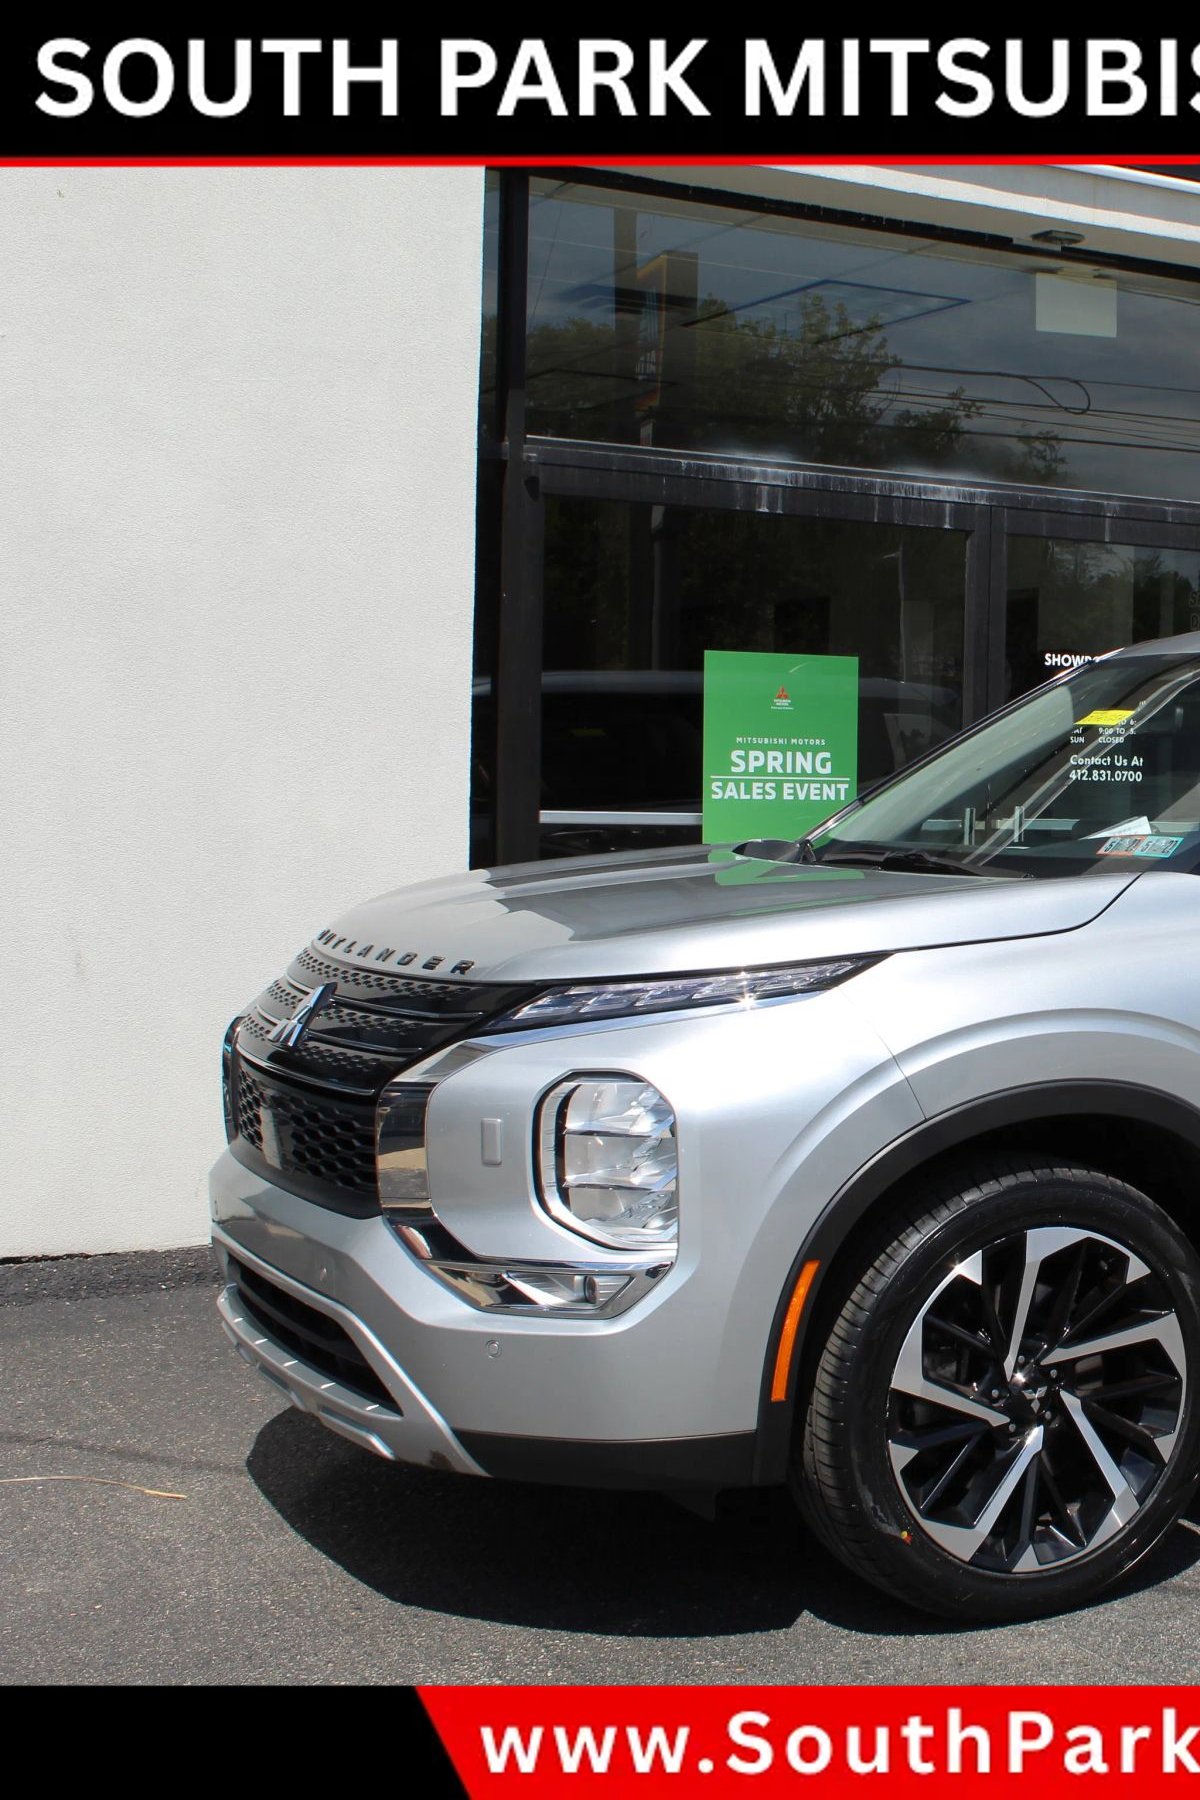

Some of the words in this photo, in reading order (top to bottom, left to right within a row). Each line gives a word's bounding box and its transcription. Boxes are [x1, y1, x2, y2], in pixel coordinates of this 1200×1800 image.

[736, 736, 788, 745] MITSUBISHI
[791, 738, 826, 746] MOTORS
[1069, 736, 1085, 744] SUN
[1098, 736, 1125, 744] CLOSED
[730, 749, 832, 774] SPRING
[1069, 755, 1111, 766] Contact
[1114, 755, 1128, 767] Us
[1131, 757, 1144, 767] At
[1069, 769, 1143, 782] 412.831.0700
[711, 781, 776, 800] SALES
[783, 783, 849, 801] EVENT
